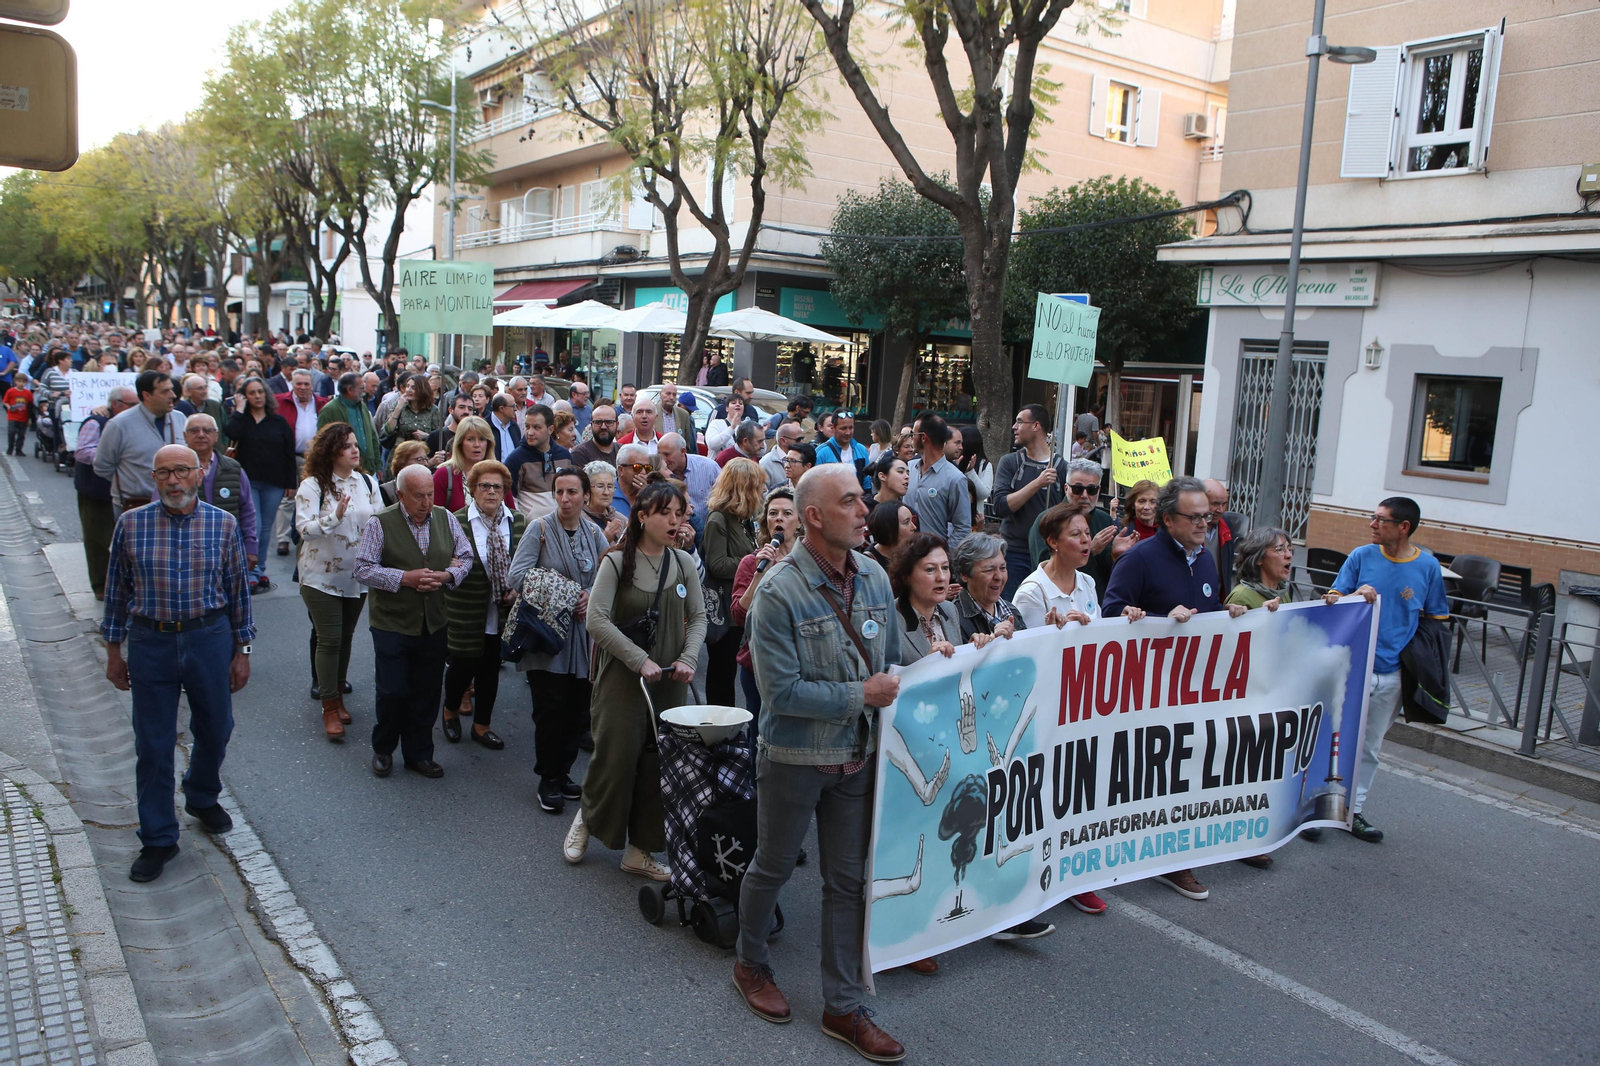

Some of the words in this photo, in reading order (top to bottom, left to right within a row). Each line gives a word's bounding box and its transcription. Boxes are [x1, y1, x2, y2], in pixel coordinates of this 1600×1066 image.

[403, 269, 437, 287] AIRE
[446, 272, 487, 285] LIMPIO
[1217, 274, 1257, 304] La
[1251, 268, 1337, 303] Alcena
[403, 298, 431, 311] PARA
[435, 295, 493, 312] MONTILLA
[793, 303, 815, 311] NUEVAS
[1038, 302, 1062, 331] NO
[1062, 312, 1074, 334] al
[1077, 313, 1096, 339] humo
[1033, 341, 1044, 359] de
[71, 378, 89, 390] POR
[78, 391, 94, 400] SIN
[1058, 631, 1252, 726] MONTILLA
[983, 753, 1045, 856] POR
[1053, 736, 1099, 819] UN
[1107, 722, 1194, 808] AIRE
[1201, 701, 1324, 790] LIMPIO
[1060, 808, 1168, 850] PLATAFORMA
[1170, 793, 1270, 824] CIUDADANA
[1059, 848, 1102, 882] POR
[1105, 838, 1137, 867] UN
[1138, 829, 1191, 860] AIRE
[1194, 816, 1269, 849] LIMPIO
